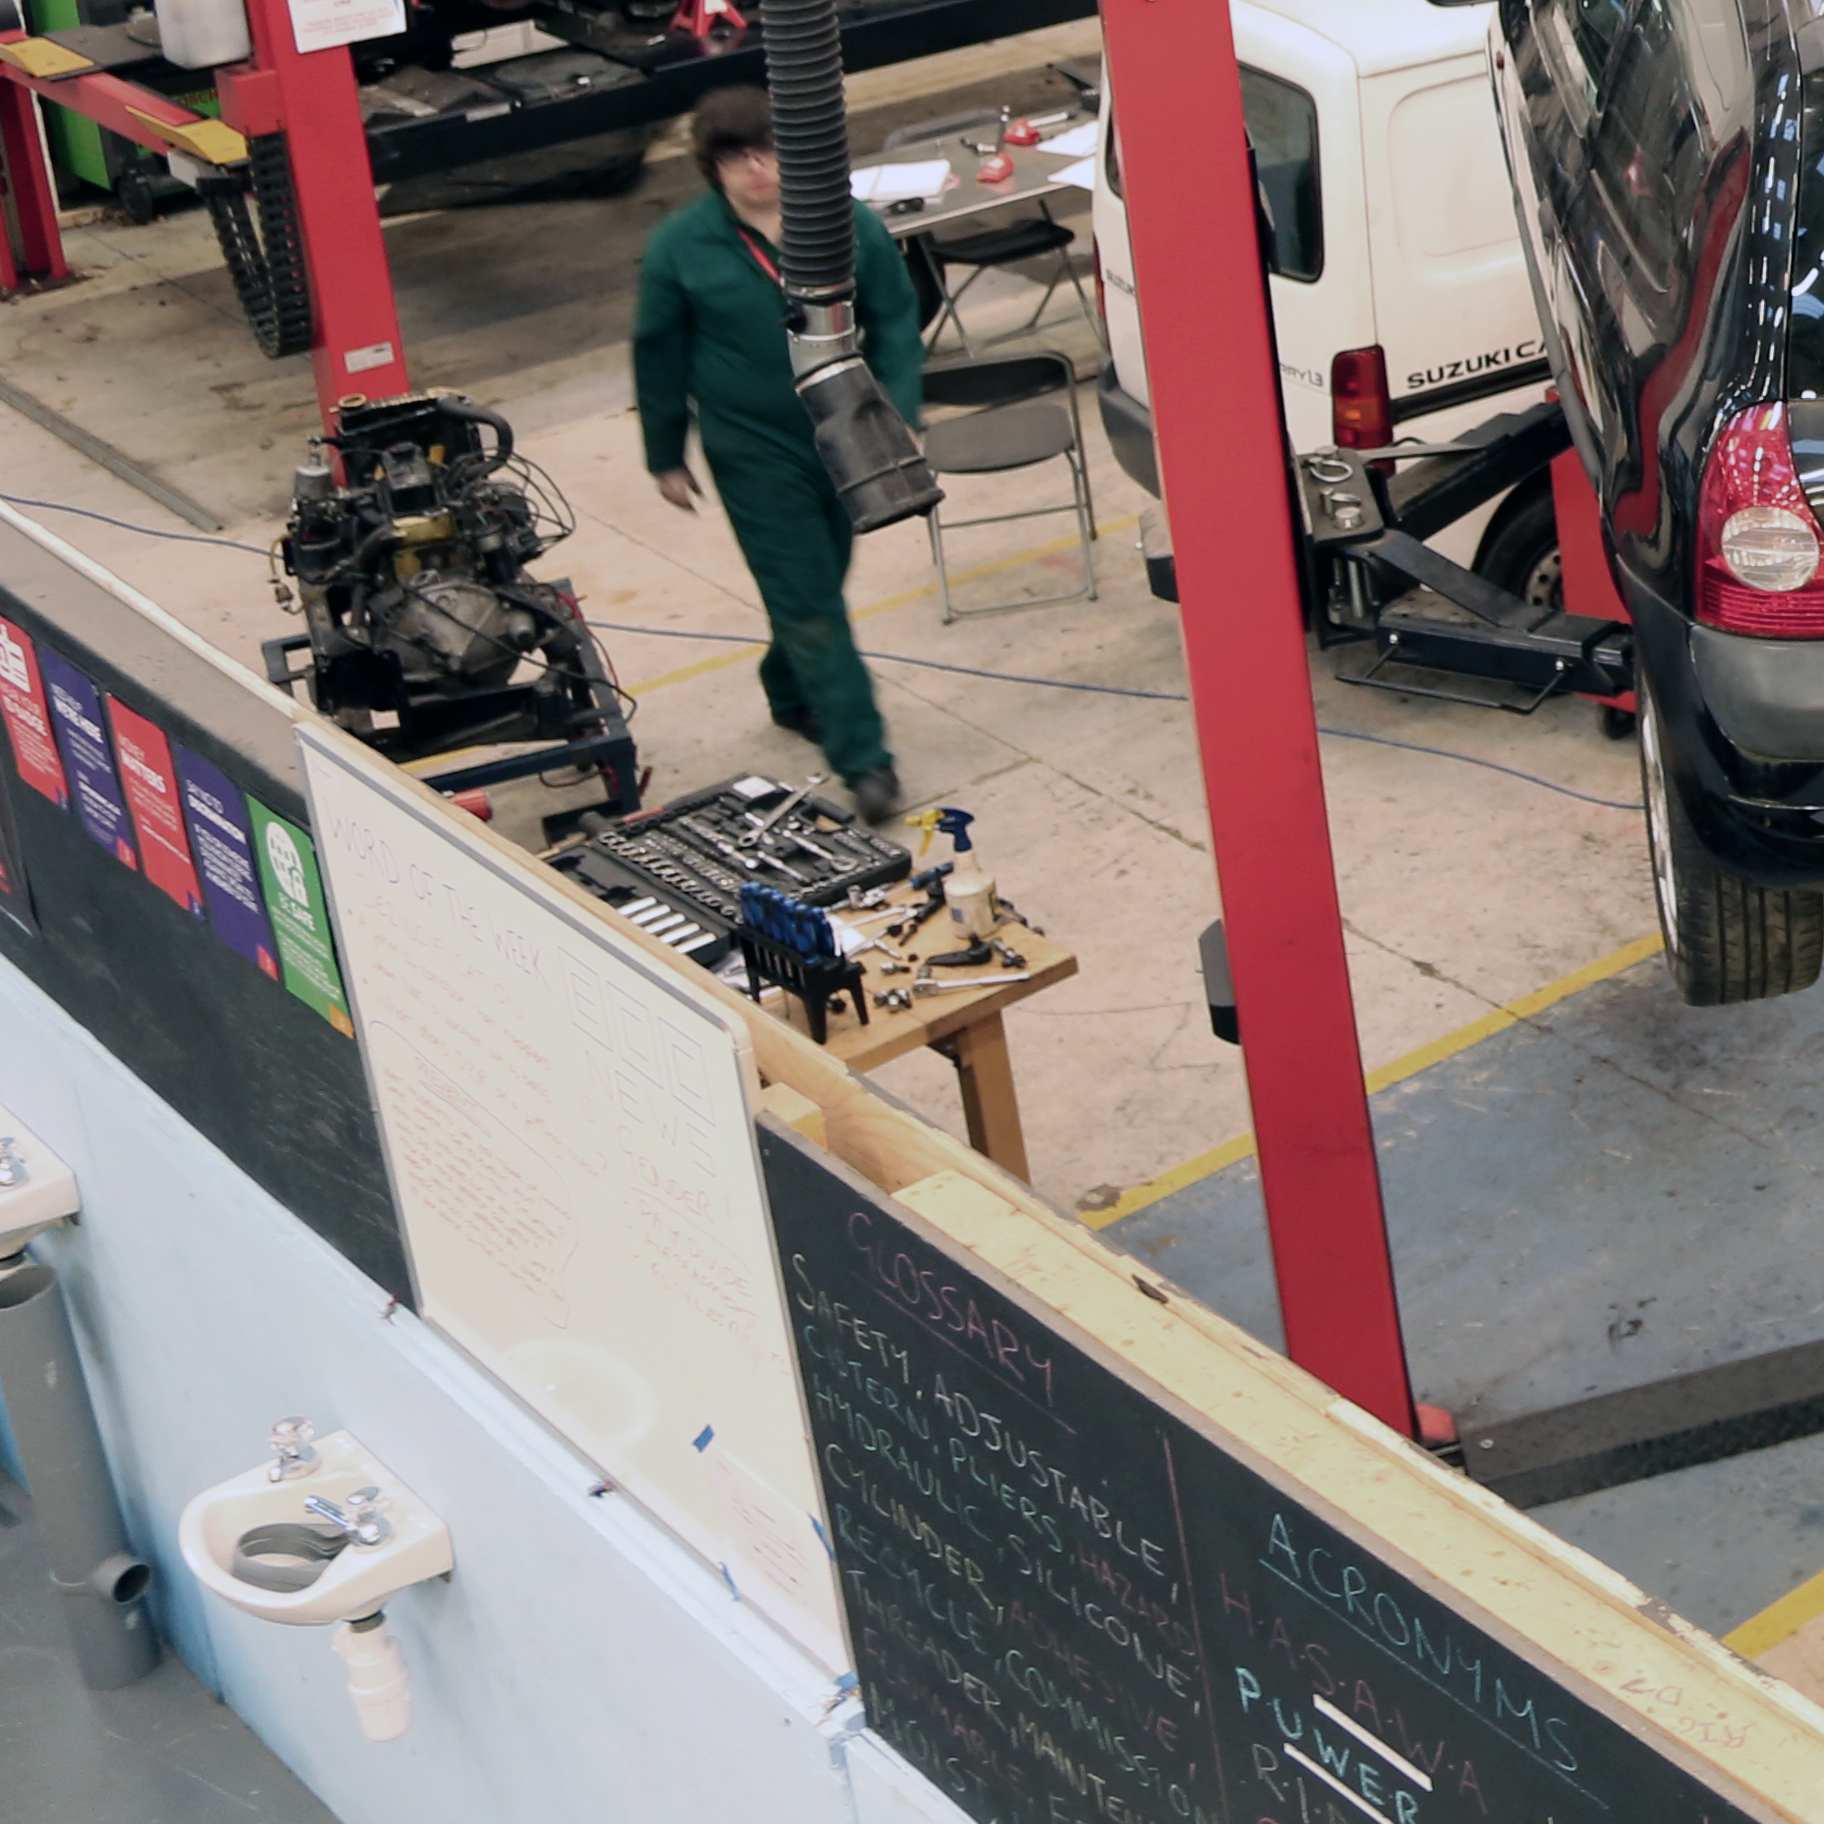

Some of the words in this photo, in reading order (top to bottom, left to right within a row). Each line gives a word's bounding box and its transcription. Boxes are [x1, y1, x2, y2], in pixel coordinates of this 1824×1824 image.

[1407, 347, 1512, 391] SUZUKI
[325, 796, 402, 885] WORD
[407, 861, 438, 908] OF
[440, 879, 485, 944] THE
[485, 910, 553, 992] WEEK
[584, 1047, 718, 1179] NEWS
[848, 1212, 1053, 1407] GLOSSARY
[1268, 1512, 1579, 1773] ACRONYMS
